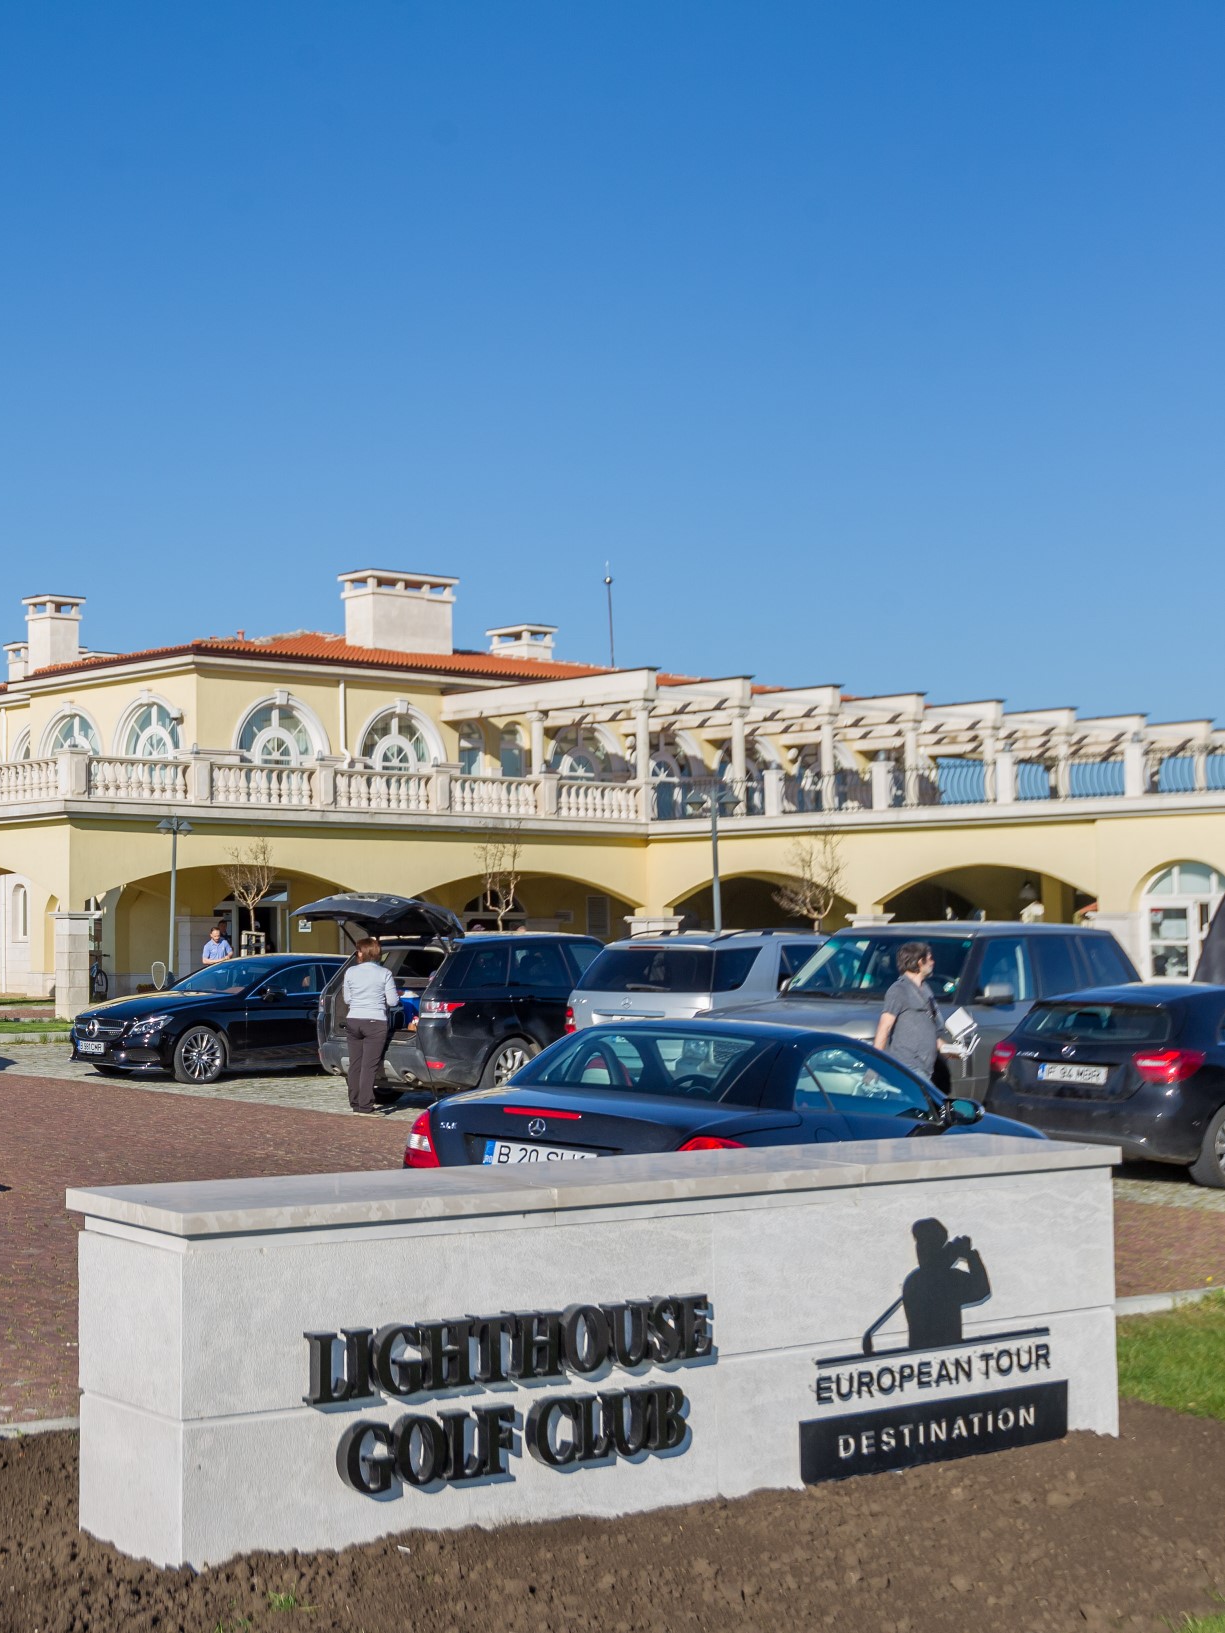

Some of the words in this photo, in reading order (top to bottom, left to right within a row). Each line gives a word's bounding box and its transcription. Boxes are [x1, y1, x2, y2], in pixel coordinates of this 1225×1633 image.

[497, 1144, 511, 1164] B
[302, 1292, 714, 1406] LIGHTHOUSE
[816, 1355, 973, 1403] EUROPEAN
[980, 1342, 1051, 1380] TOUR
[336, 1401, 515, 1494] GOLF
[525, 1382, 687, 1466] CLUB
[838, 1403, 1036, 1460] DESTINATION
